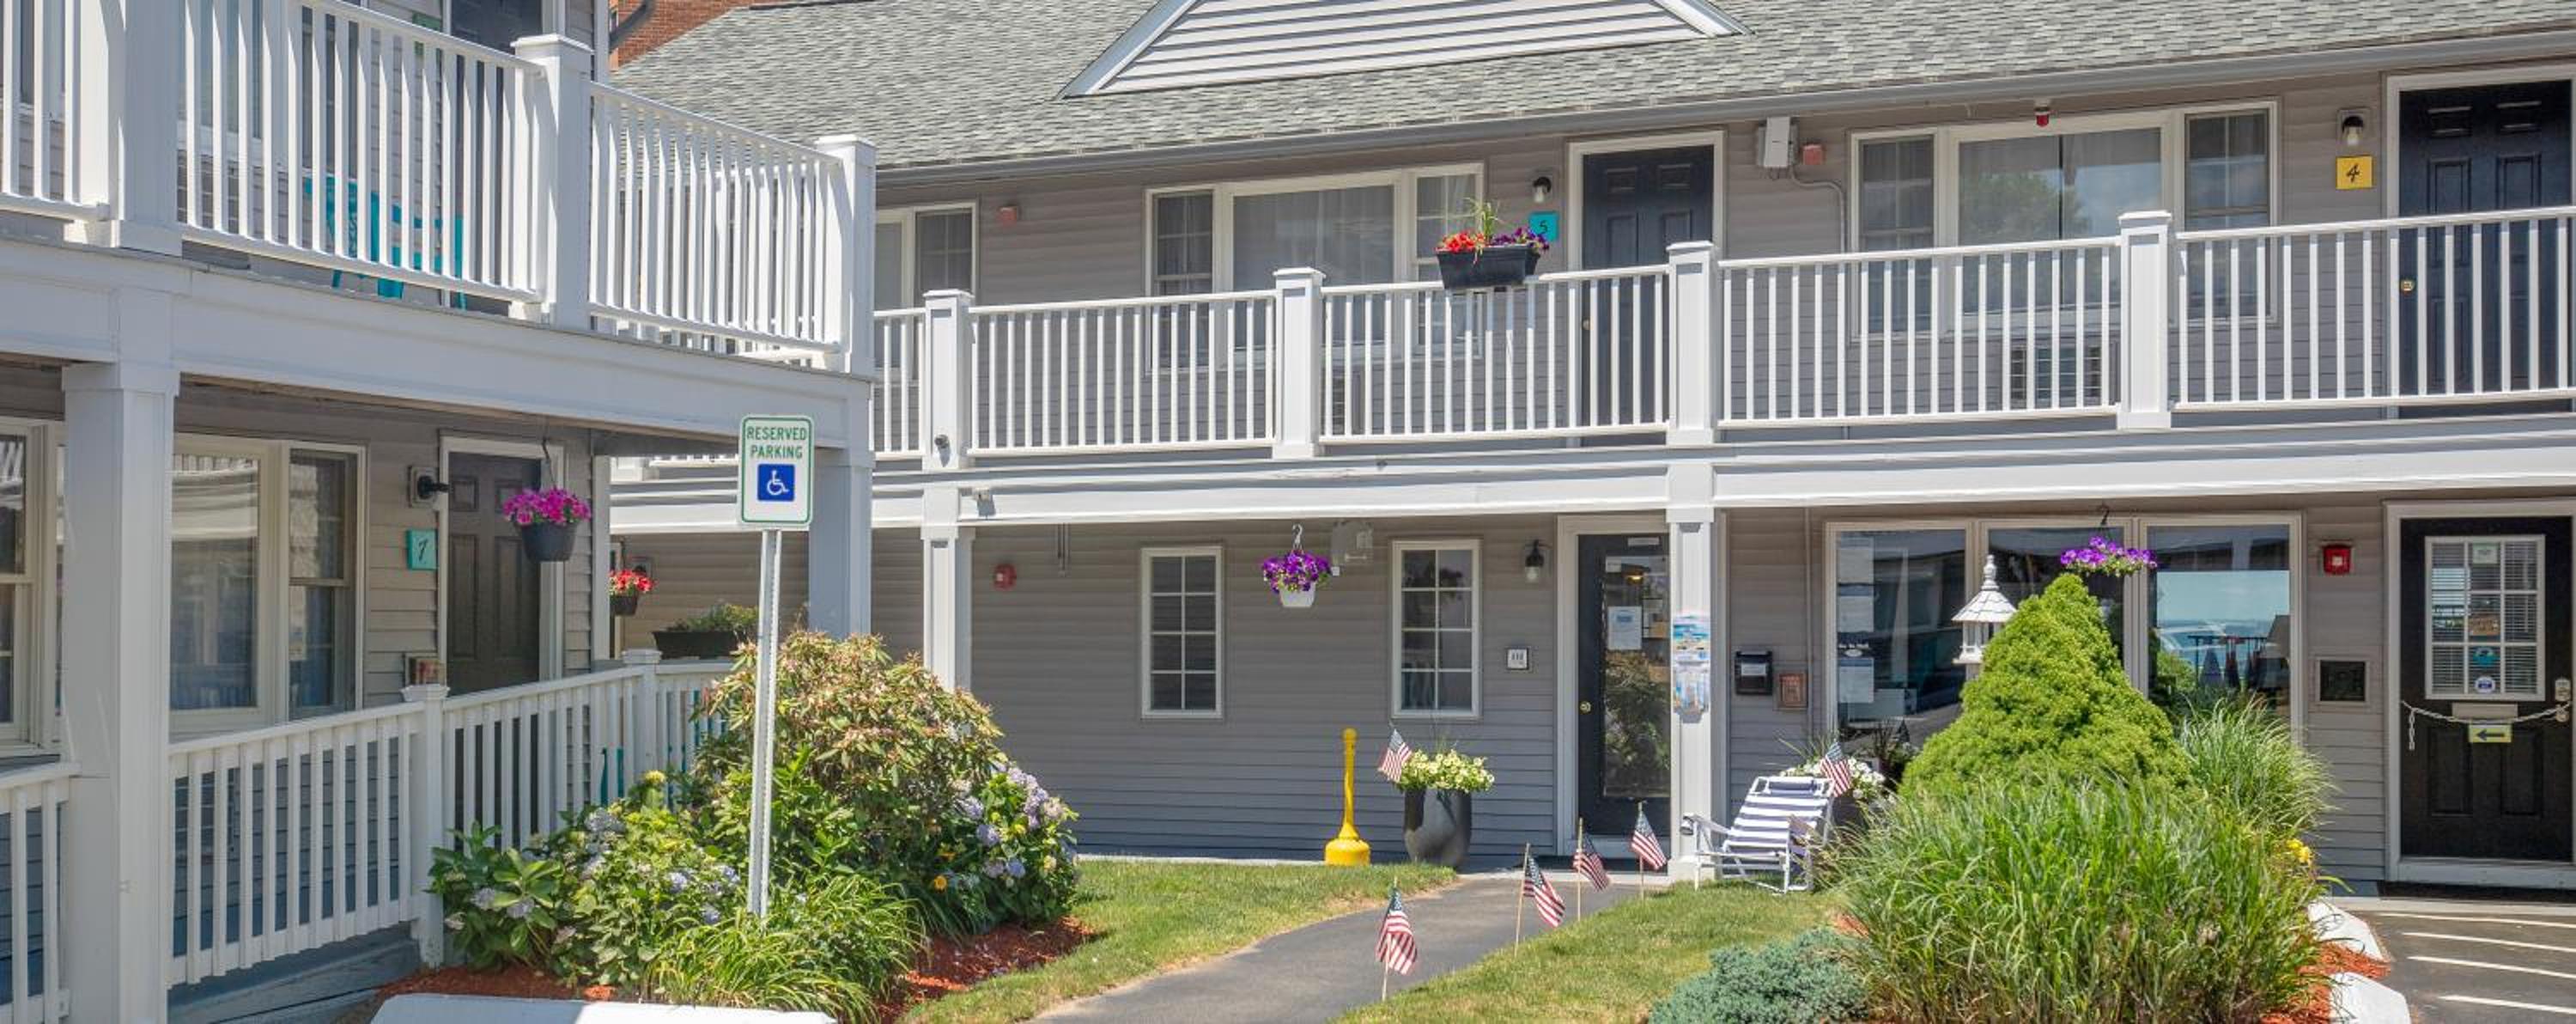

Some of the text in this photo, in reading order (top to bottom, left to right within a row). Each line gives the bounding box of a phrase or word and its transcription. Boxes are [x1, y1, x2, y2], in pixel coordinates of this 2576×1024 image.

[2346, 163, 2360, 183] 4
[746, 427, 807, 441] RESERVED
[750, 444, 803, 459] PARKING
[418, 539, 428, 562] 7
